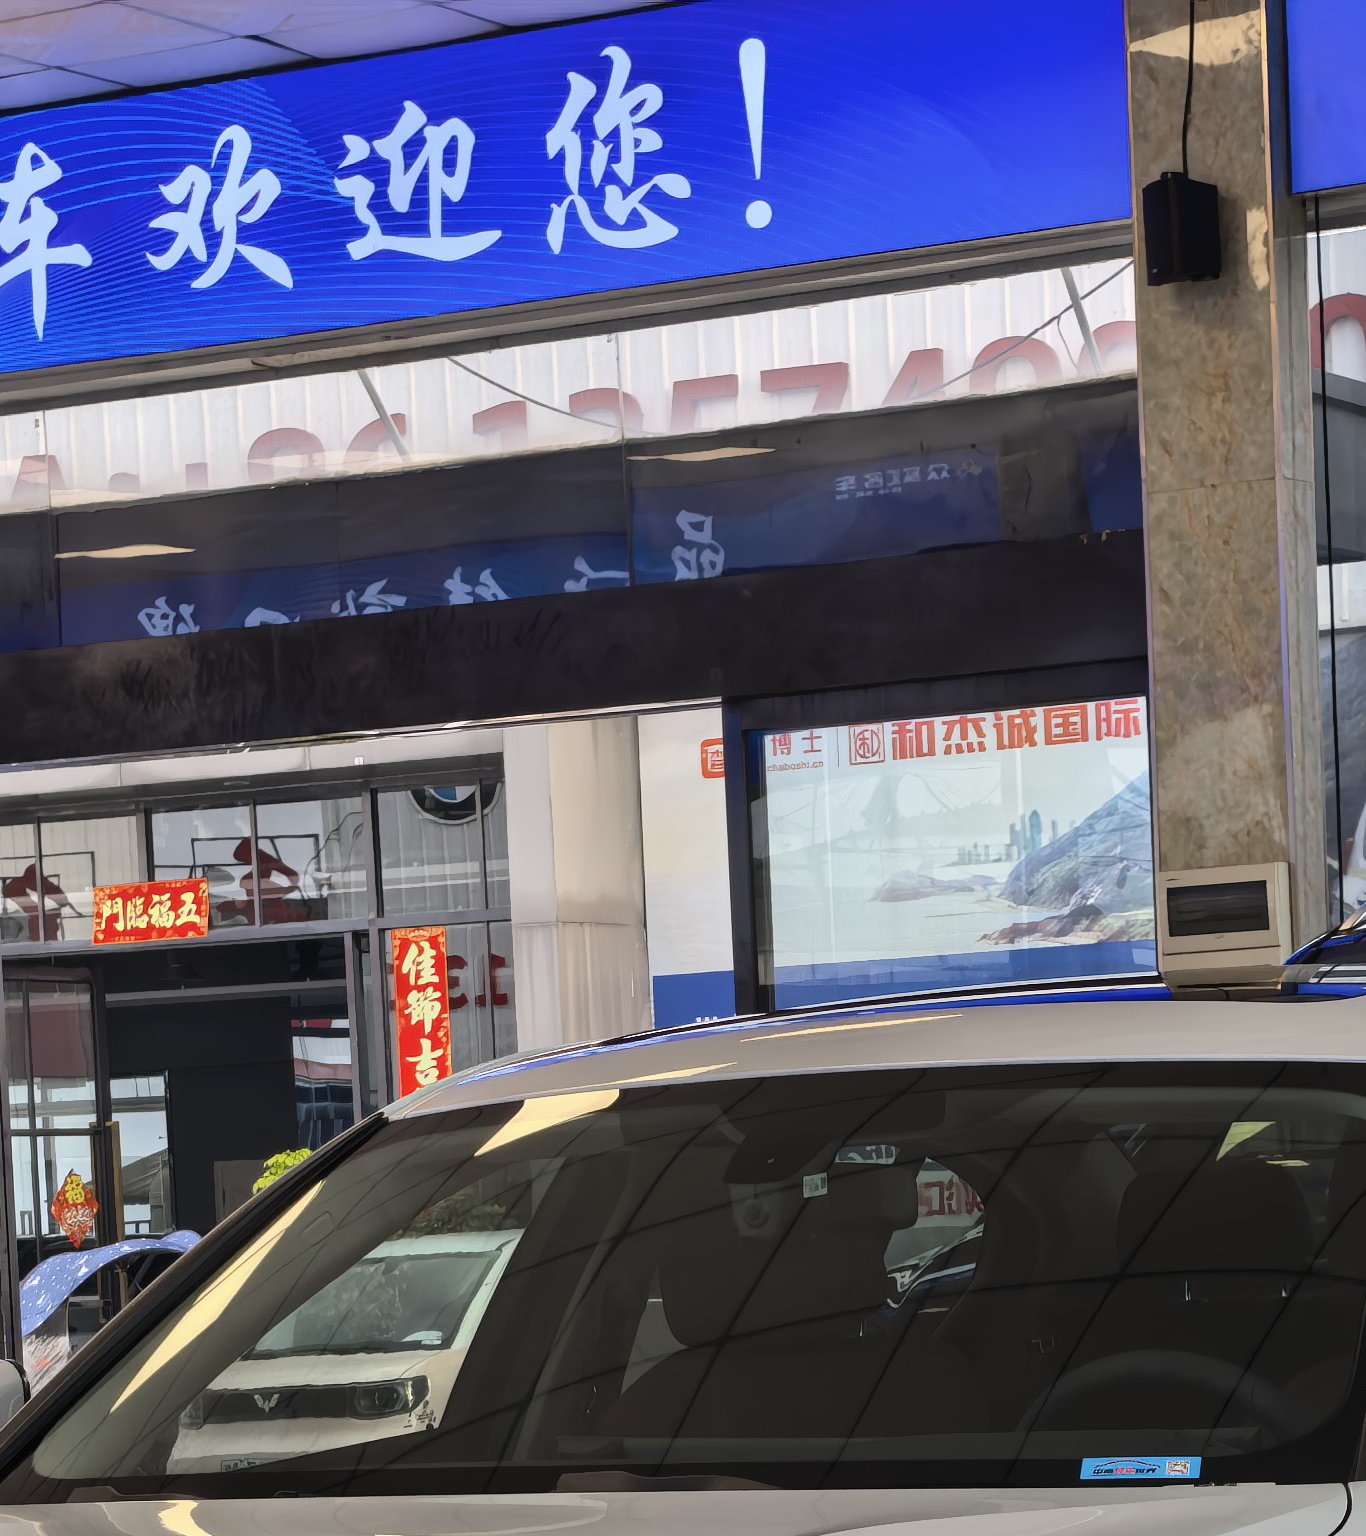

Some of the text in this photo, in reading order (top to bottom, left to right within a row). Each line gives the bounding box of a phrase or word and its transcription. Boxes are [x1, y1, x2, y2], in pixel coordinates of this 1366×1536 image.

[891, 700, 1144, 761] 和杰诚国际
